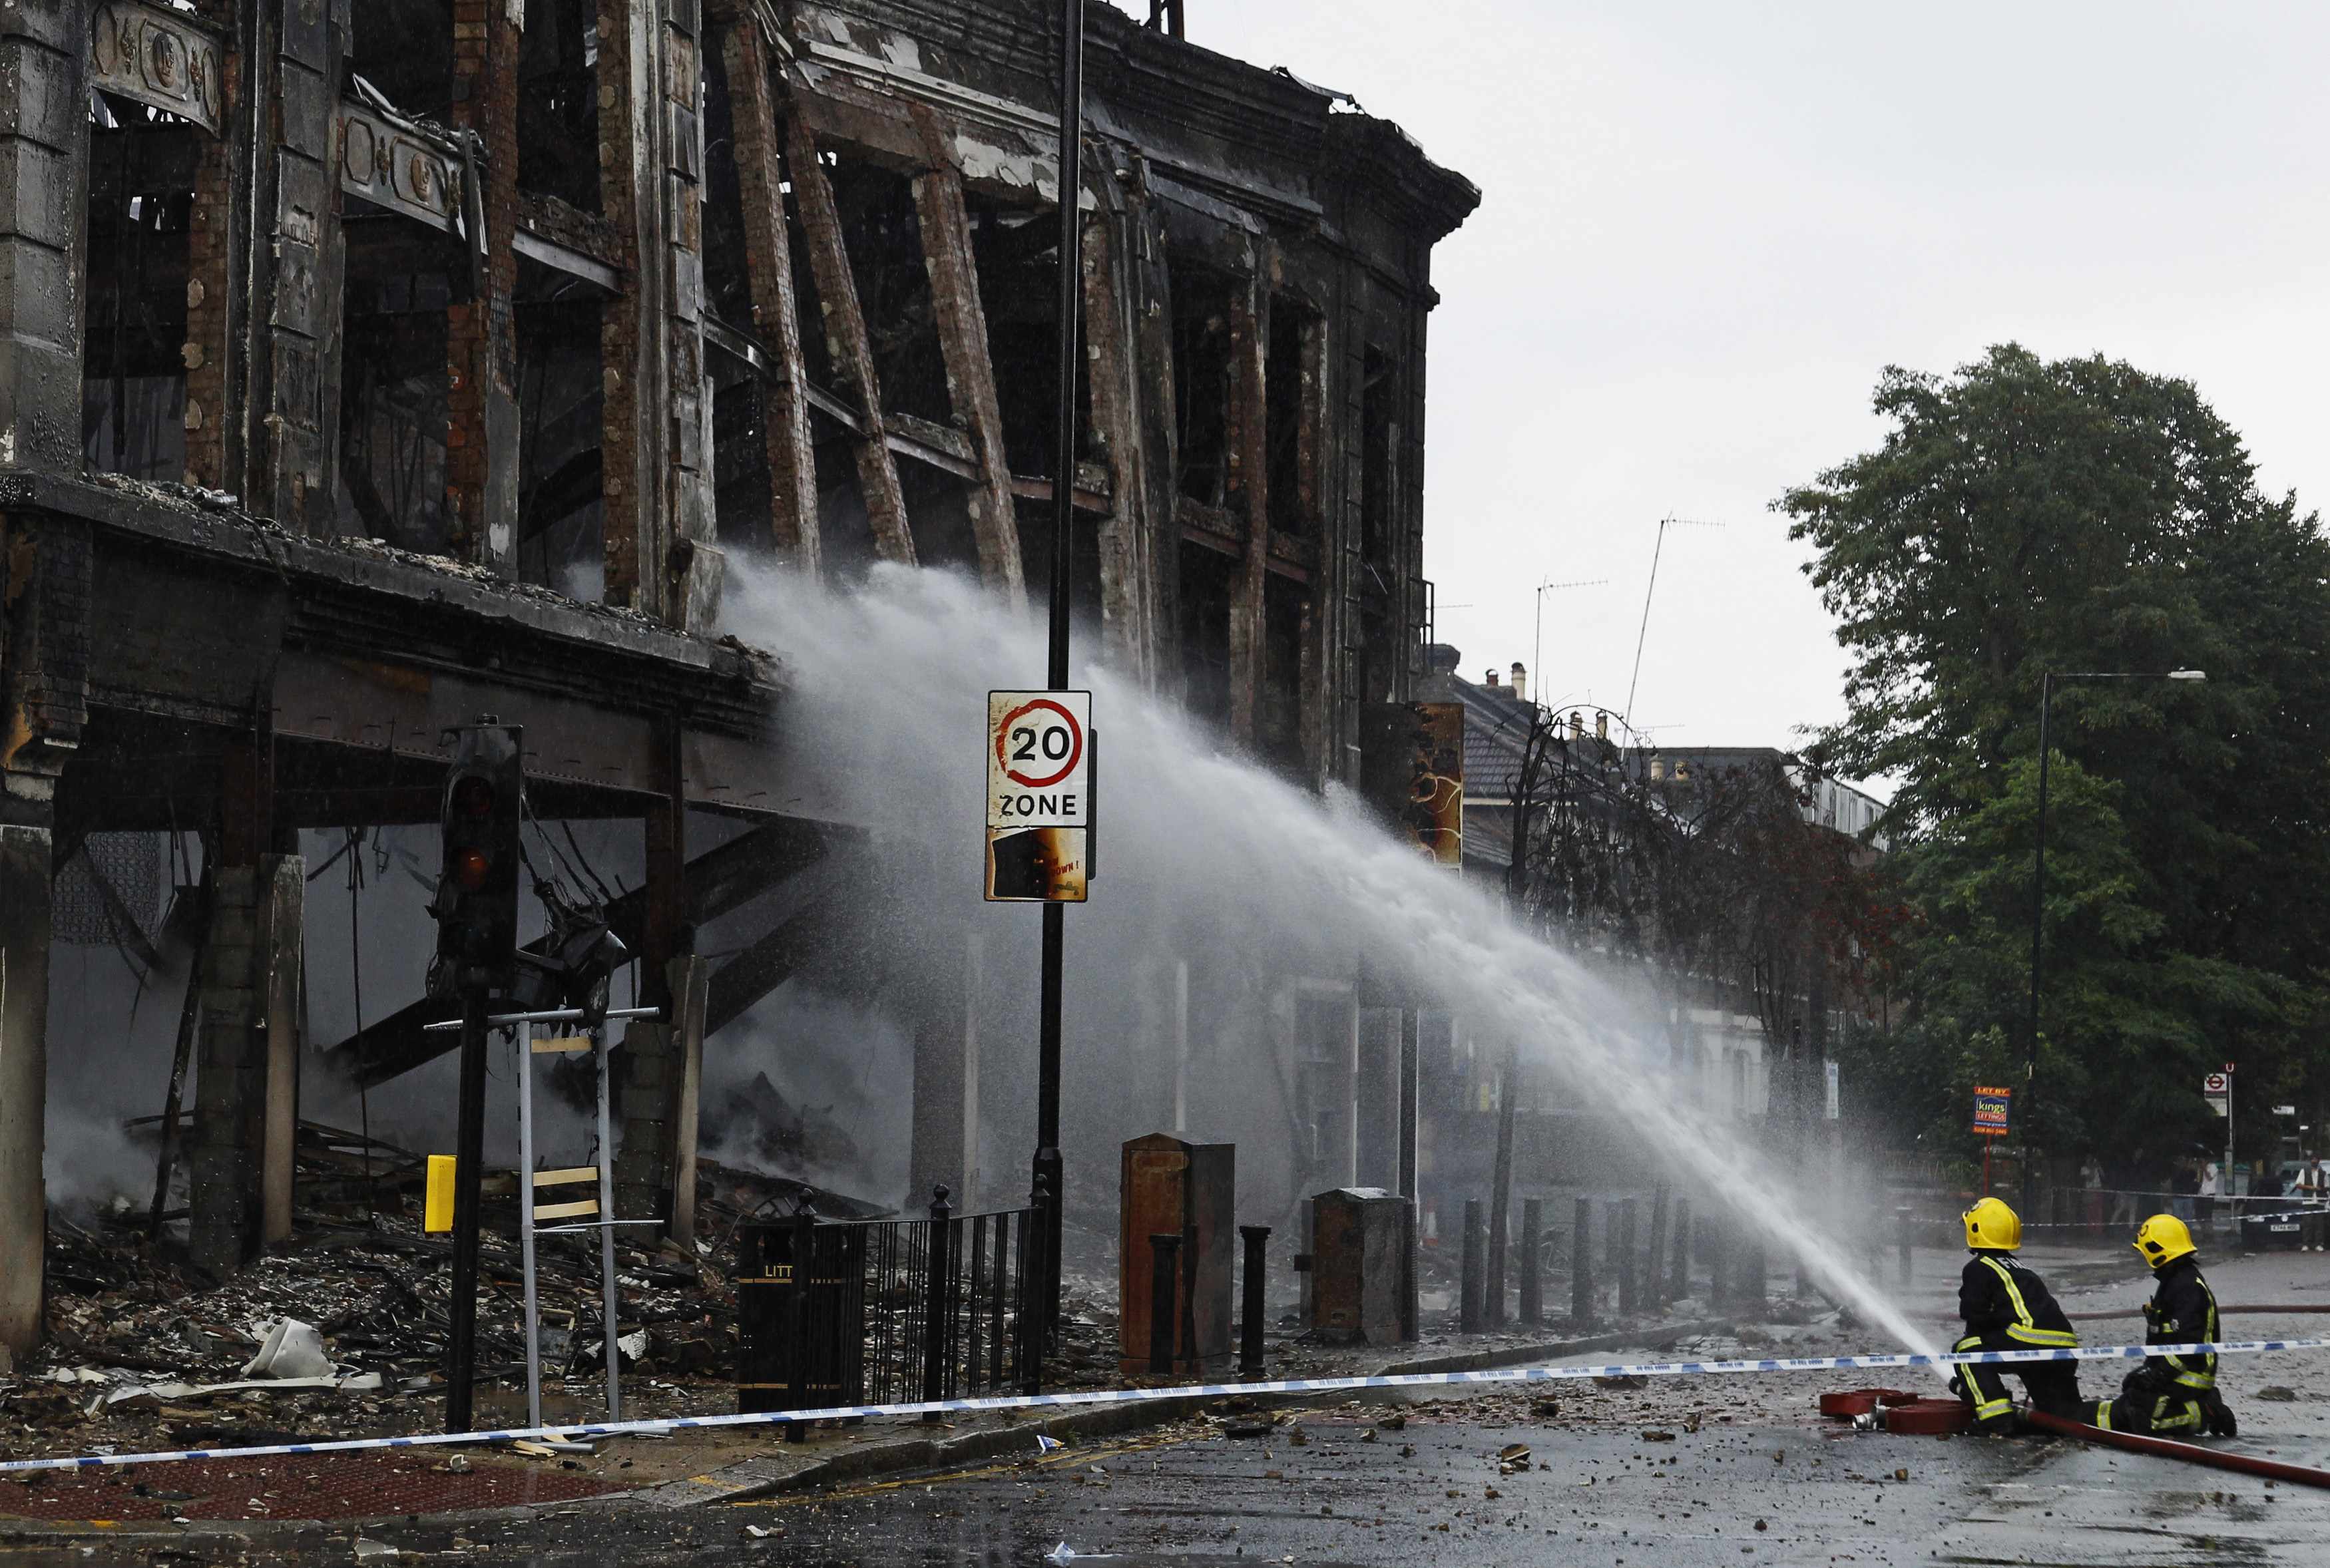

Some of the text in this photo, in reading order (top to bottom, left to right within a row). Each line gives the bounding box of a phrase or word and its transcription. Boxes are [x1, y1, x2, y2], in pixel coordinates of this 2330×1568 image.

[1012, 725, 1070, 761] 20
[999, 795, 1076, 817] ZONE
[1979, 1101, 2005, 1114] kings
[765, 1265, 793, 1277] LITT
